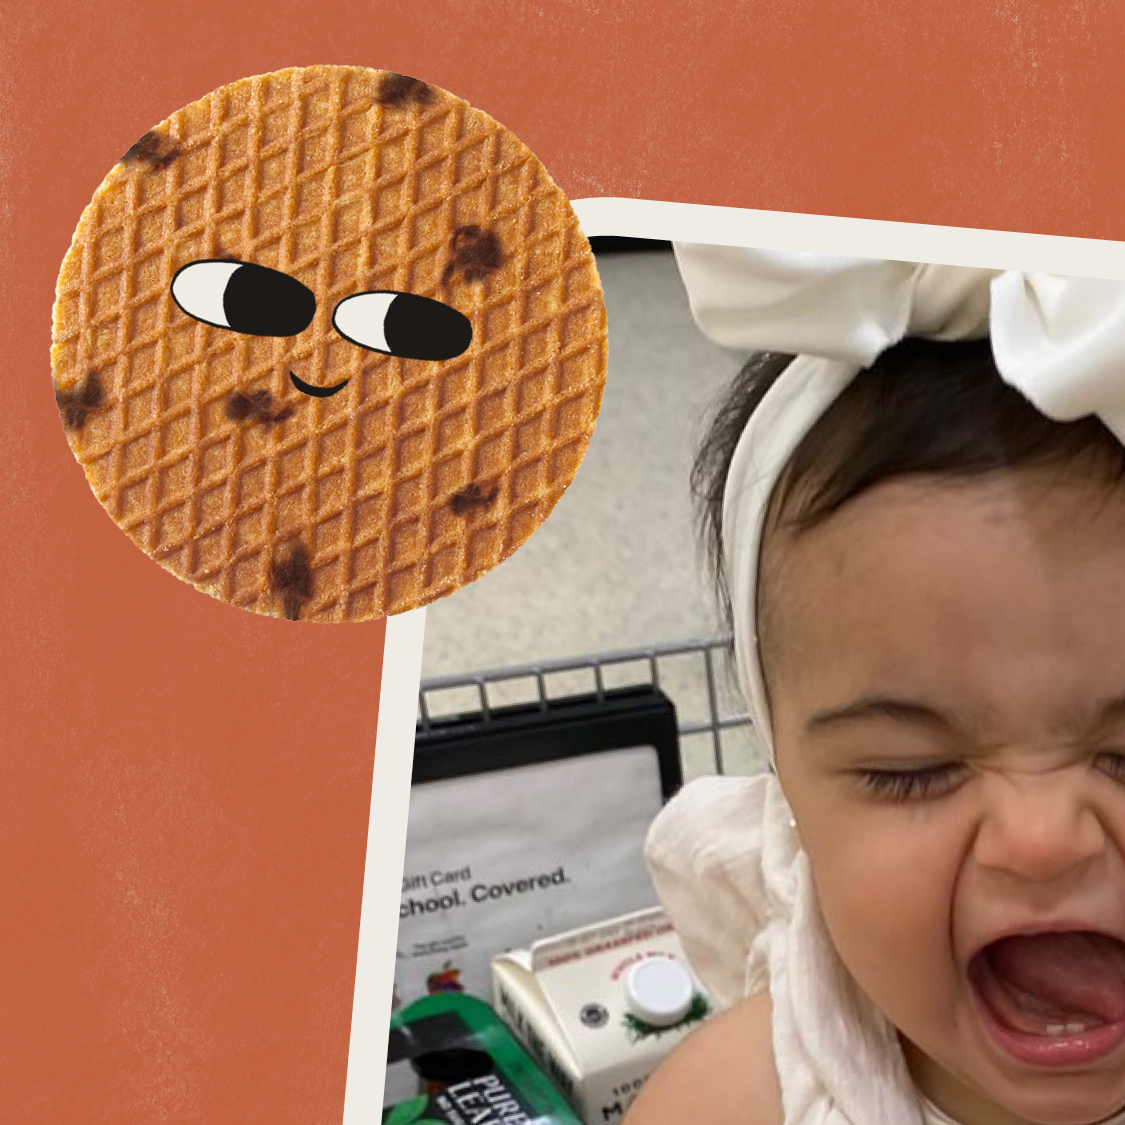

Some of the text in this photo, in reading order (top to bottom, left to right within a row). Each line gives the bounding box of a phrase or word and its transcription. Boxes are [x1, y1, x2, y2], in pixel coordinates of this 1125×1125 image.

[430, 865, 472, 886] Card
[471, 866, 571, 902] Covered.
[613, 1074, 650, 1096] 100
